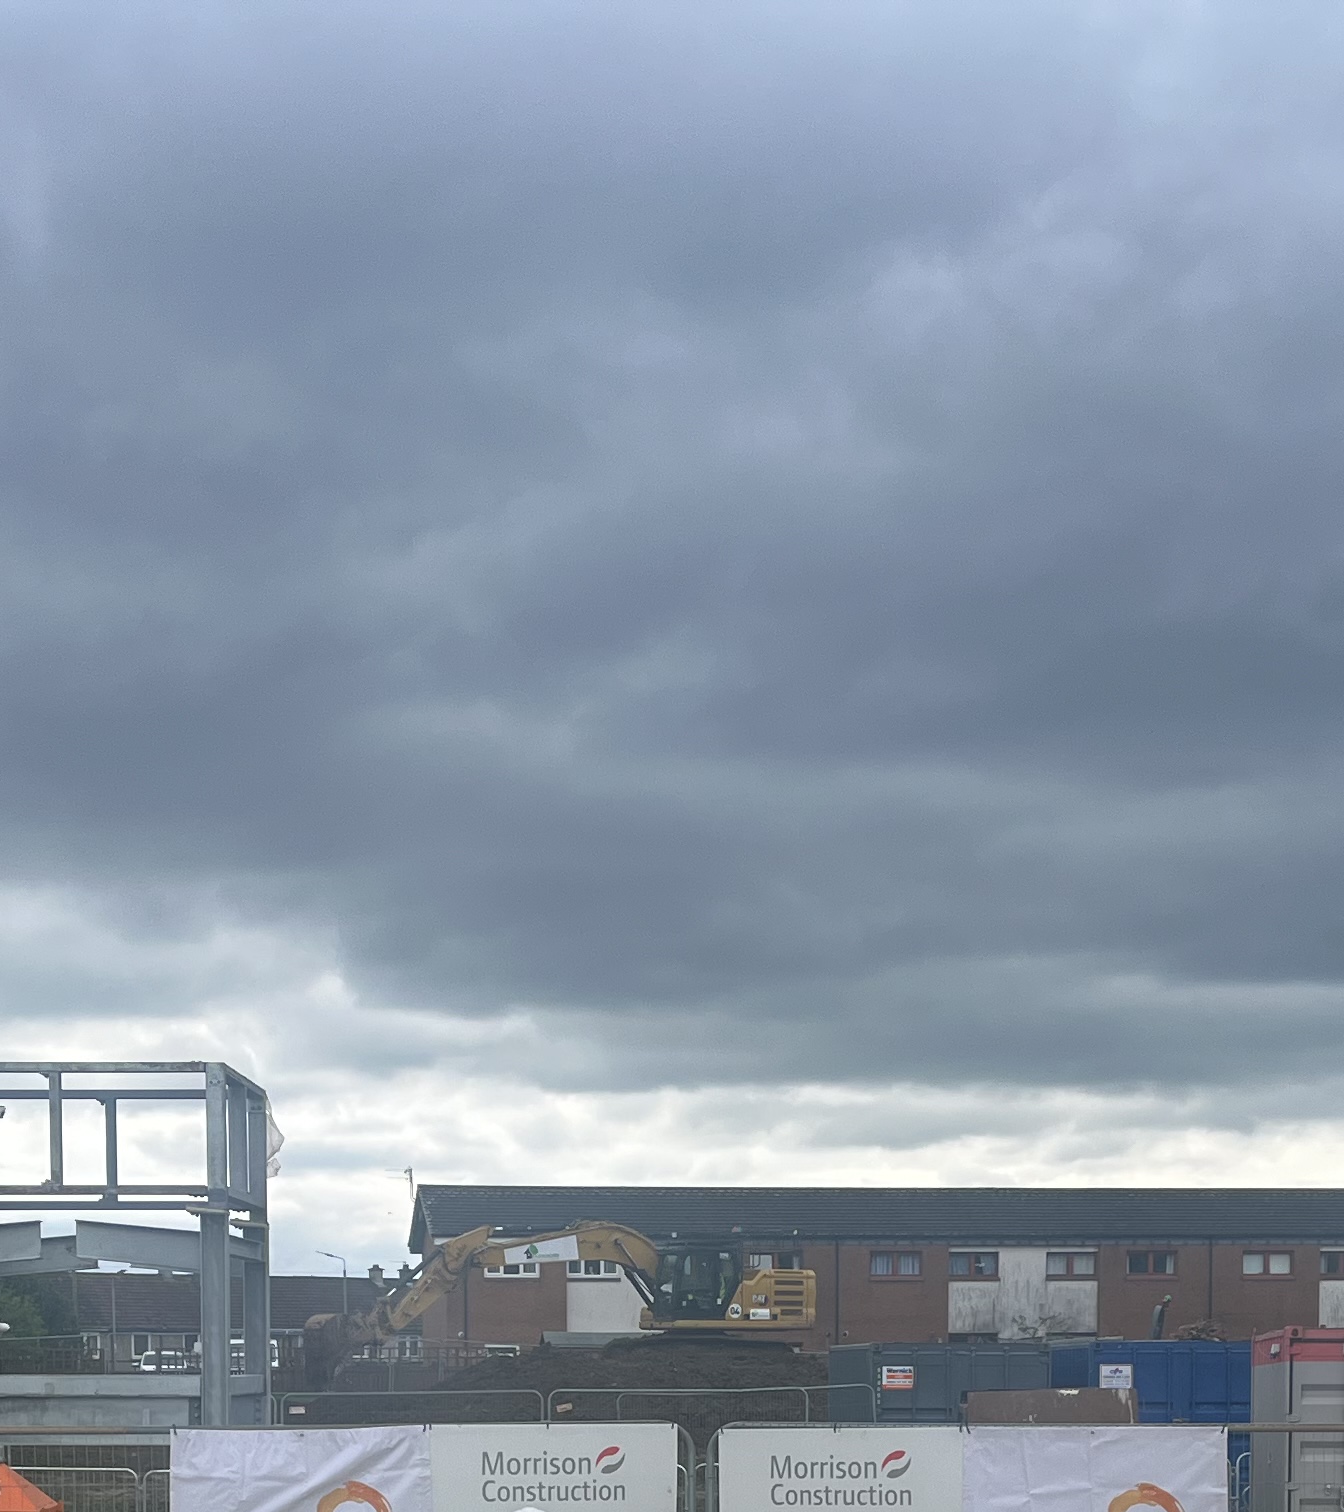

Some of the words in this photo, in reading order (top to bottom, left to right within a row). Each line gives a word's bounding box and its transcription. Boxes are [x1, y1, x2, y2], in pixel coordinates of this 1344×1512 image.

[481, 1451, 592, 1475] Morrison
[770, 1455, 877, 1479] Morrison
[482, 1479, 626, 1502] Construction
[771, 1484, 912, 1506] Construction
